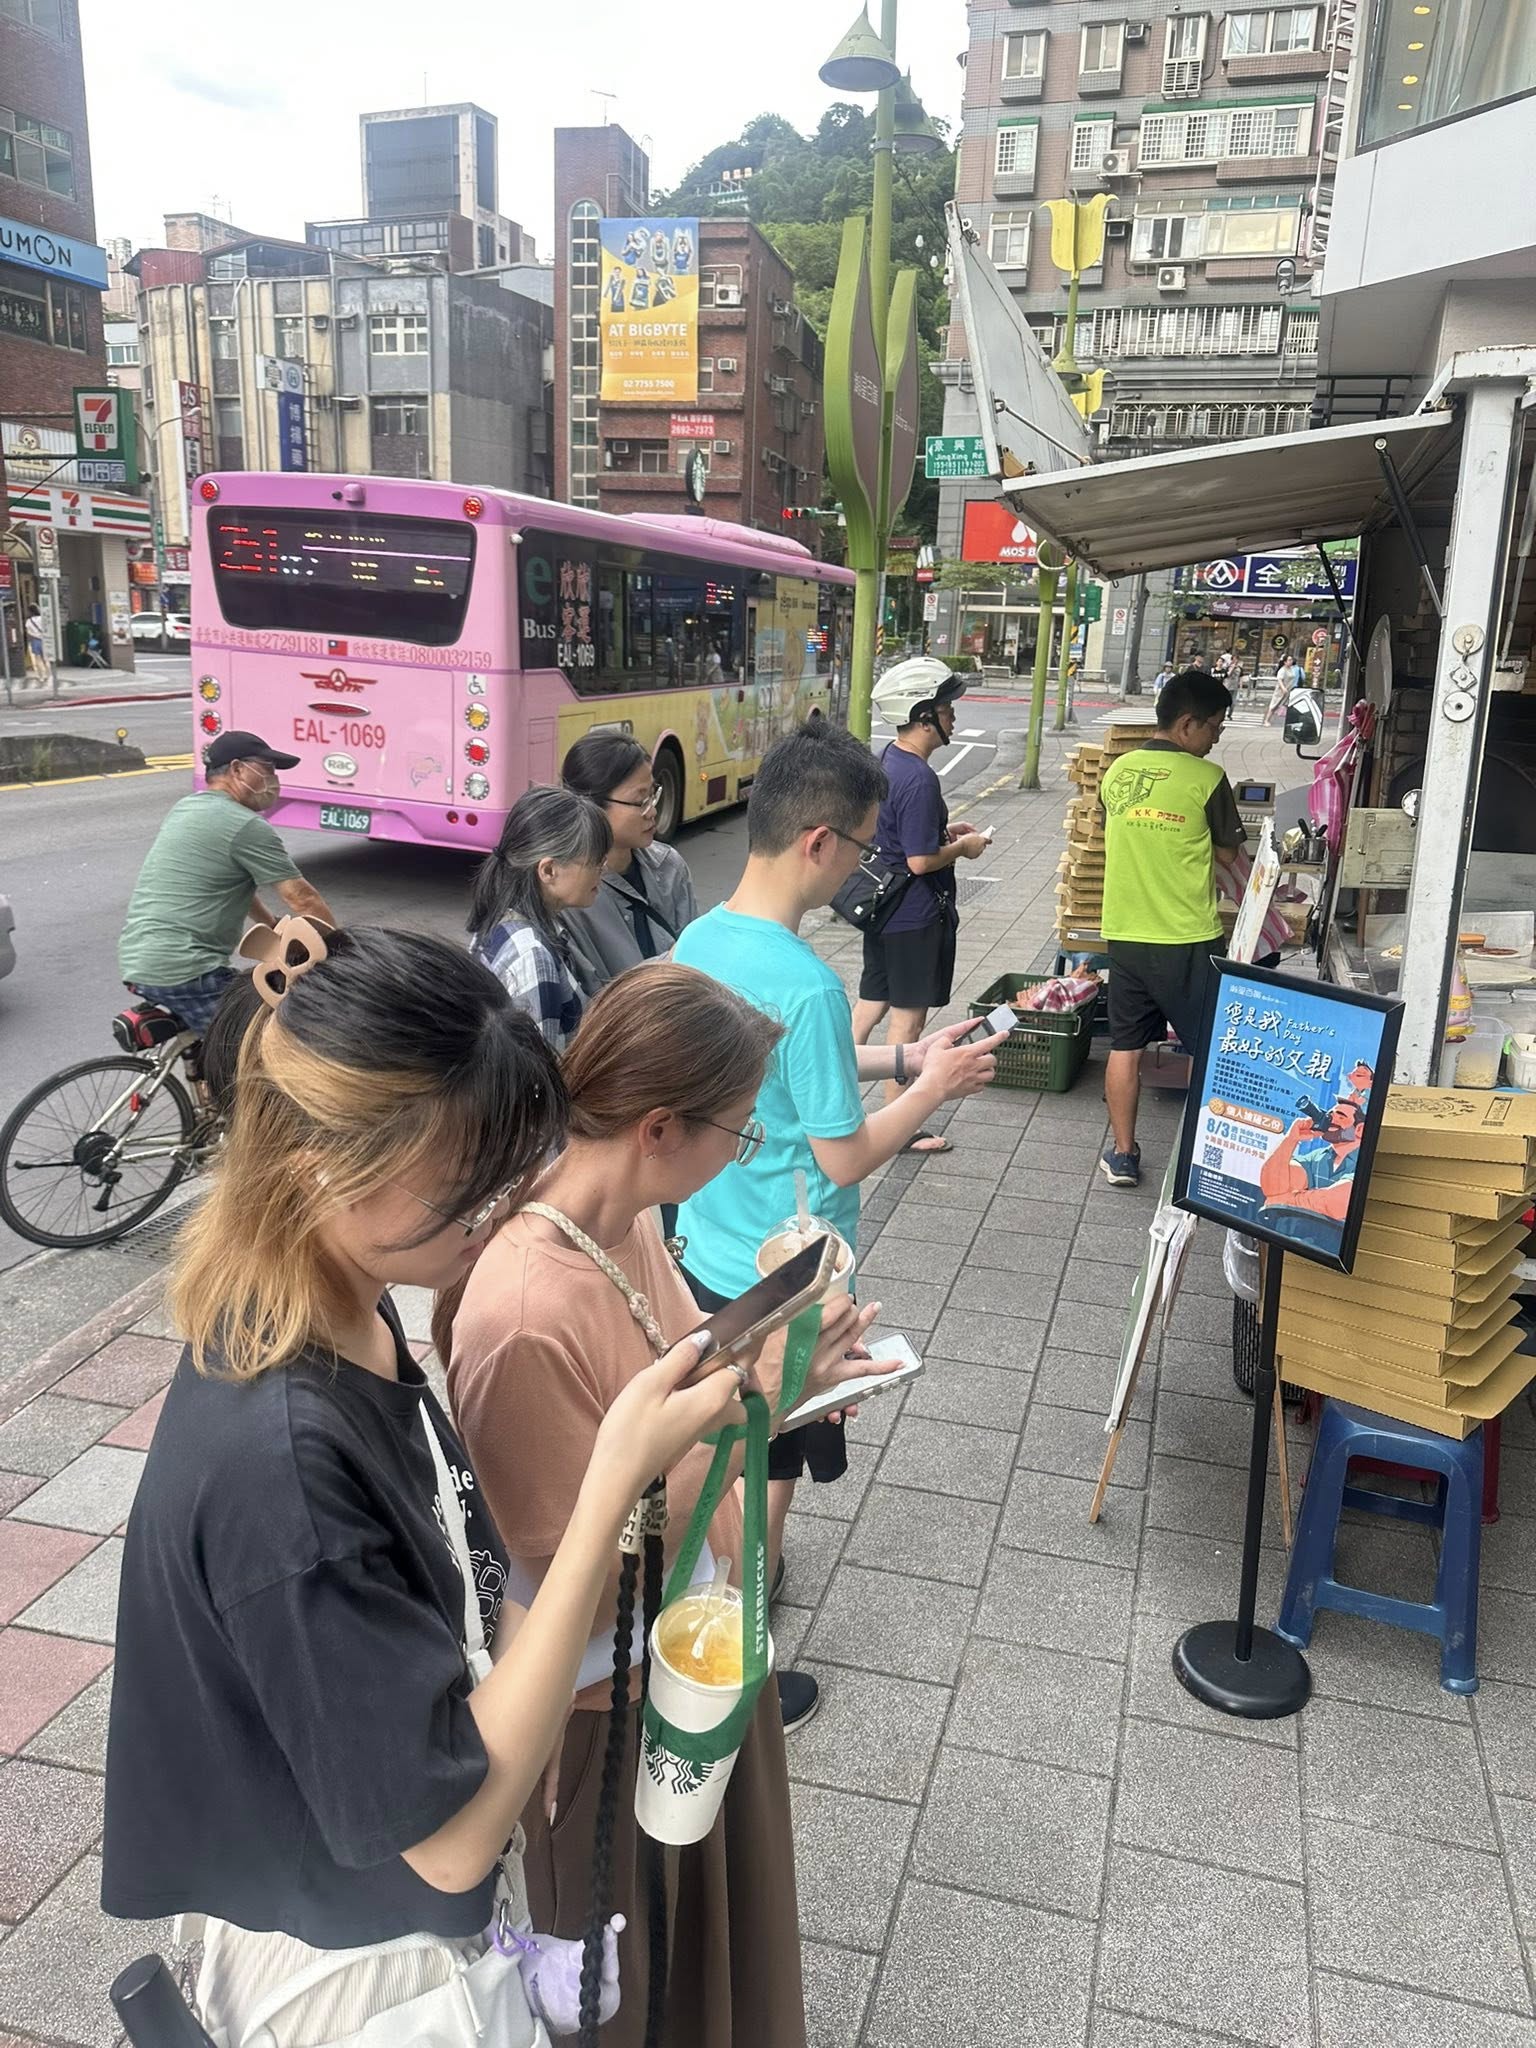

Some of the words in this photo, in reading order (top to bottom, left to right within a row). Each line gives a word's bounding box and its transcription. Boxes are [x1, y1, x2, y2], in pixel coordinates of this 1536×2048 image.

[609, 323, 625, 337] AT
[628, 323, 688, 337] BIGBYTE
[1000, 547, 1026, 557] MOS
[523, 618, 556, 639] Bus
[557, 643, 596, 668] EAL-1069
[293, 718, 386, 749] EAL-1069
[320, 810, 370, 830] EAL-1069
[1224, 1000, 1284, 1038] 您是我
[1286, 1018, 1337, 1037] Father's
[1283, 1029, 1302, 1047] Day
[1218, 1026, 1333, 1083] 最好的父親
[1207, 1117, 1230, 1138] 8/3
[755, 1543, 765, 1655] STARBUCKS
